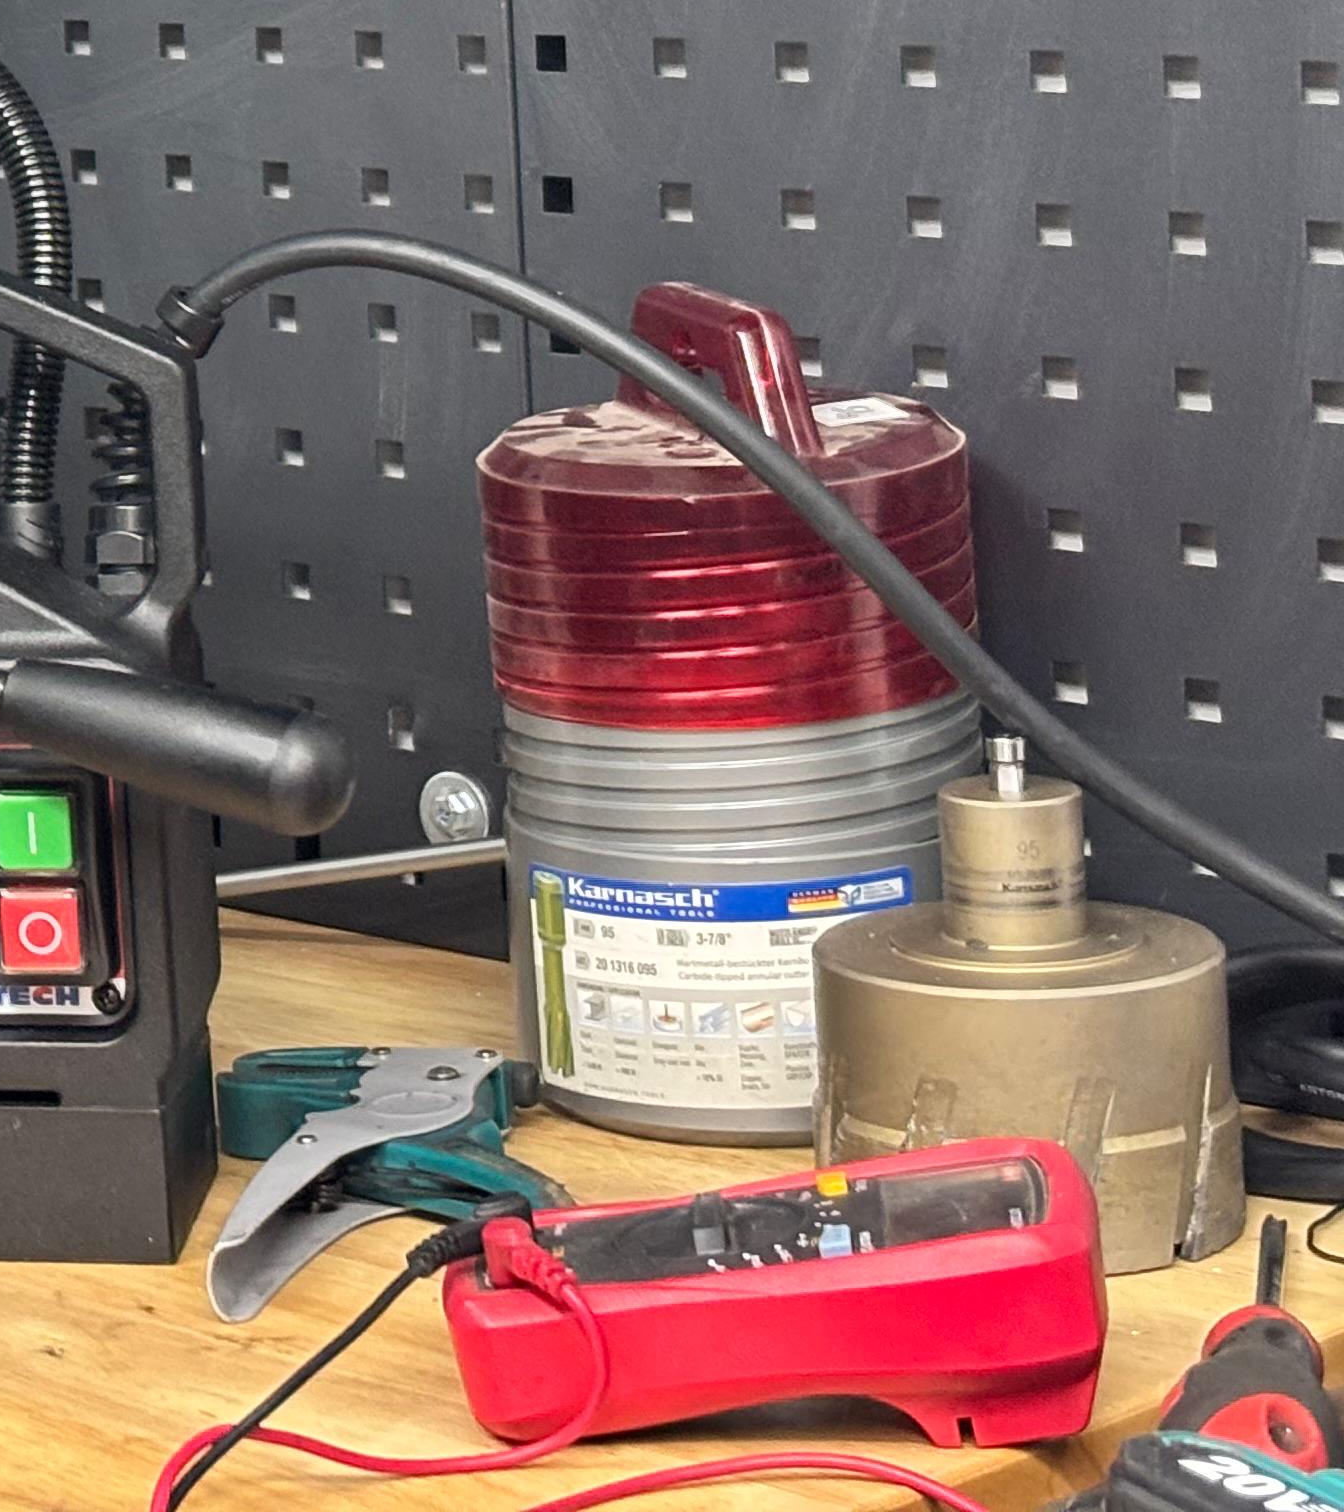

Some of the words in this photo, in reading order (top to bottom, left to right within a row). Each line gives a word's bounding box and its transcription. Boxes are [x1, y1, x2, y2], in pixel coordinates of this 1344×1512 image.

[567, 876, 716, 909] Karnasch
[568, 898, 661, 916] PROFESSIONAL
[670, 909, 716, 918] TOOLS
[600, 924, 616, 940] 95
[595, 957, 608, 972] 20
[610, 959, 635, 975] 1316
[637, 962, 658, 978] 095
